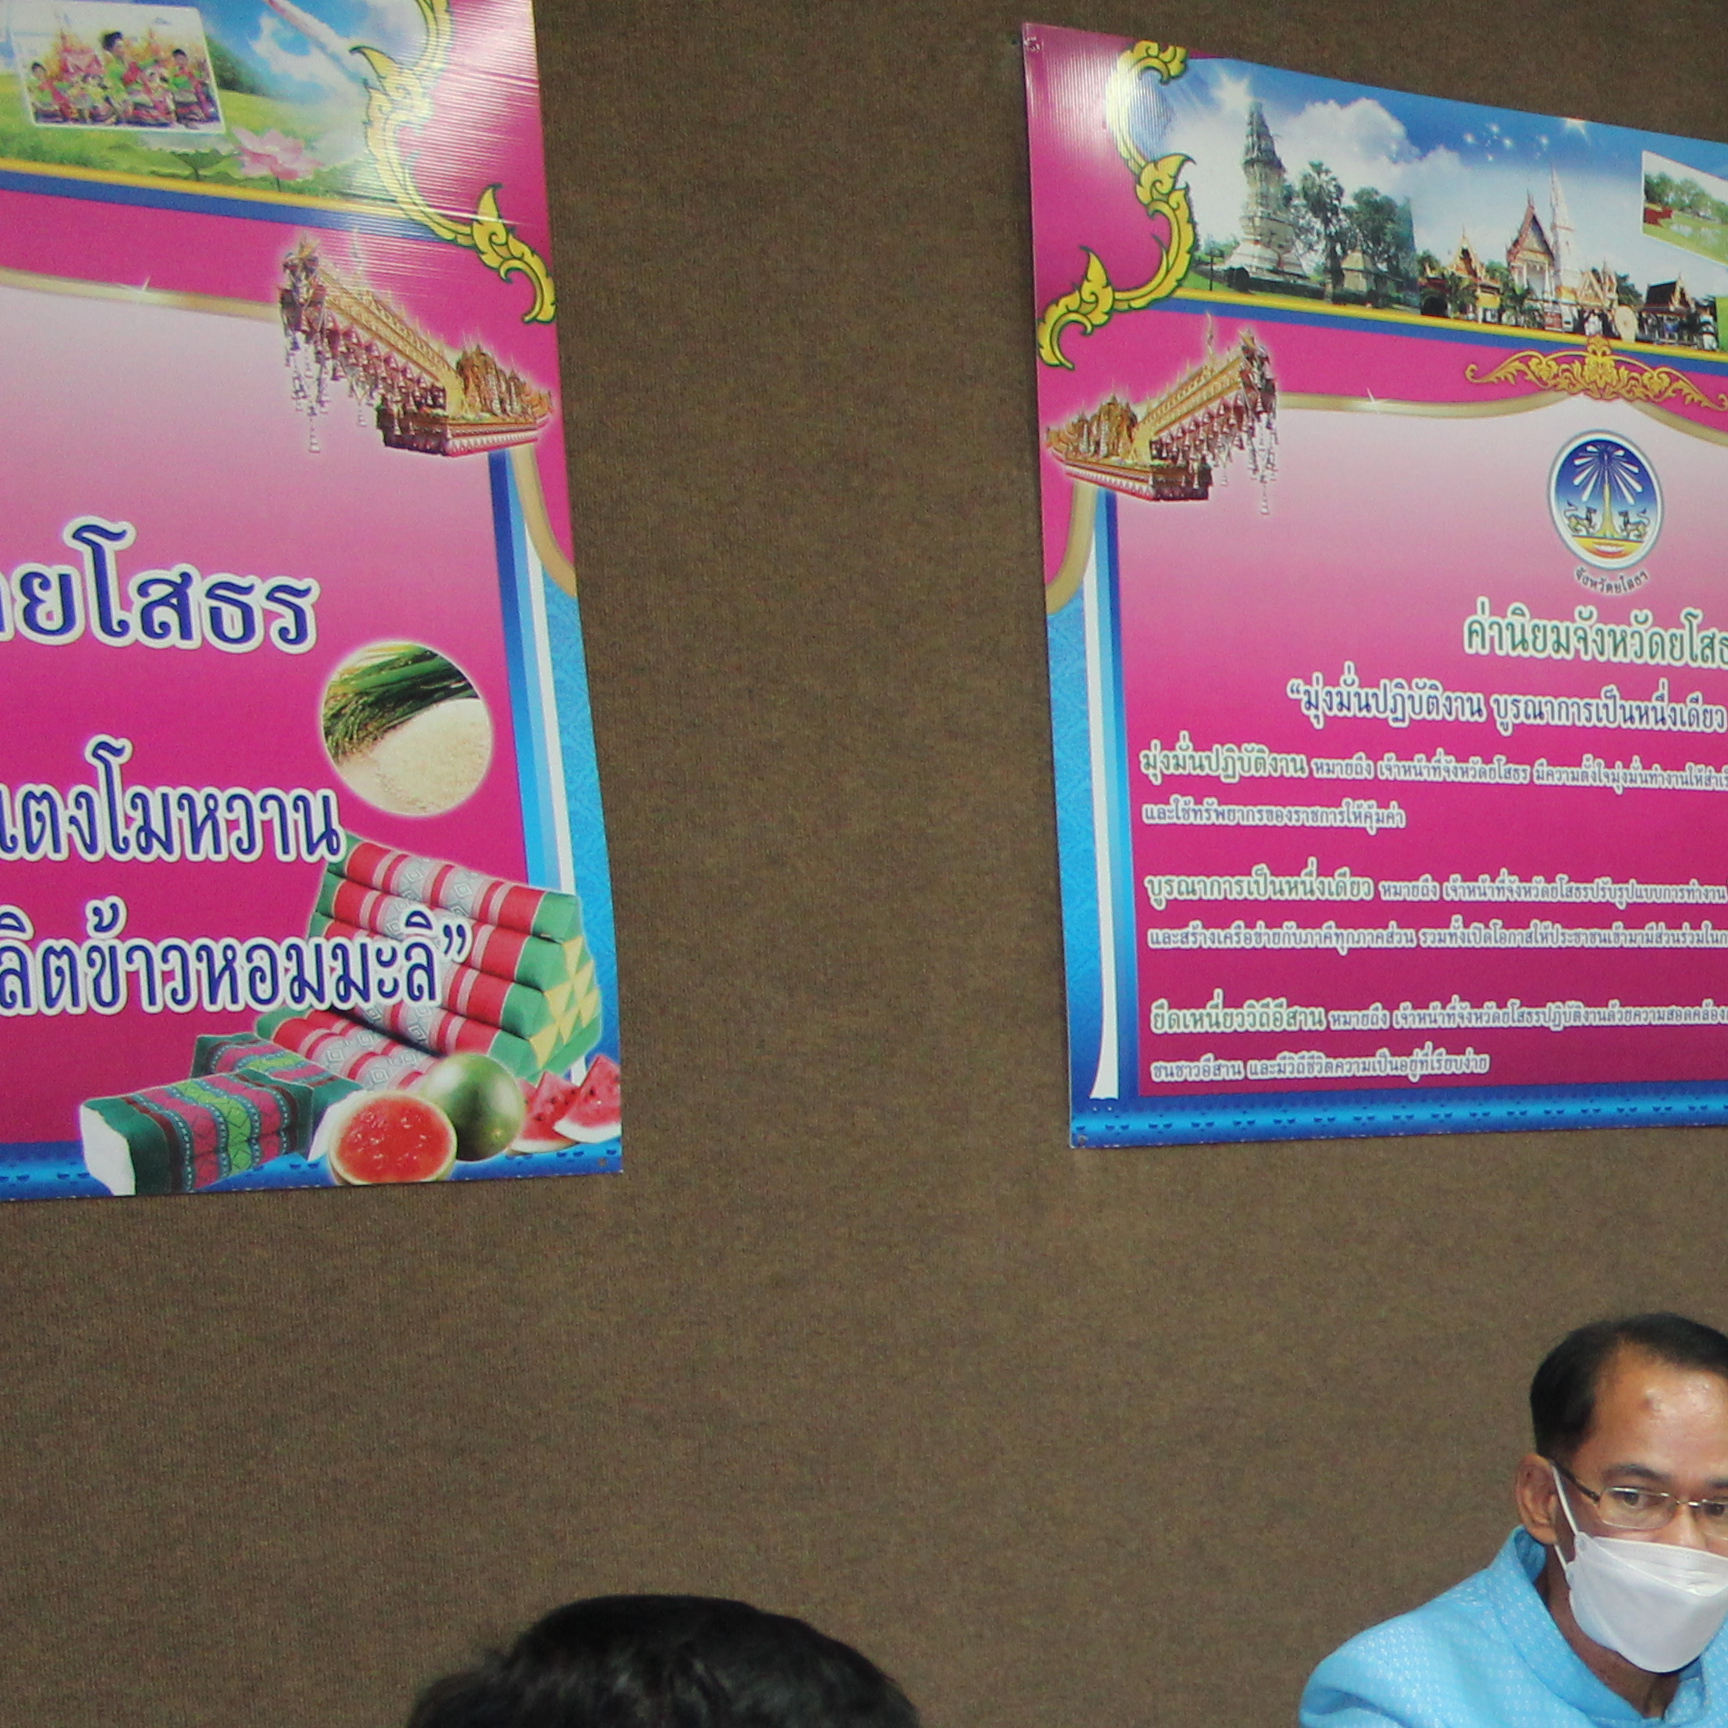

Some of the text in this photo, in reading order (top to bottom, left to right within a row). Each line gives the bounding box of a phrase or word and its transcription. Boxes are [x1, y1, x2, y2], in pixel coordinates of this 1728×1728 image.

[0, 523, 314, 646] ยโสธร
[1576, 567, 1648, 594] จังหวัดยโสธร
[1289, 663, 1485, 728] “มุ่งมั่นปฏิบัติงาน
[1492, 680, 1727, 734] บูรณาการเป็นหนึ่งเดียว
[1140, 732, 1306, 784] มุ่งมั่นปฏิบัติงาน
[1312, 753, 1373, 779] หมายถึง
[1378, 749, 1530, 785] เจ้าหน้าที่จังหวัดยโสธร
[1144, 796, 1406, 834] และใช้ทรัพยากรของราชการให้คุ้มค่า
[1145, 857, 1373, 909] บูรณาการเป็นหนึ่งเดียว
[1380, 874, 1439, 900] หมายถึง
[1152, 989, 1326, 1033] ยึดเหนี่ยววิถีอีสาน
[1330, 1003, 1389, 1029] หมายถึง
[1152, 1042, 1490, 1081] ชนชาวอีสาน และมีวิถีชีวิตความเป็นอยู่ที่เรียบง่าย
